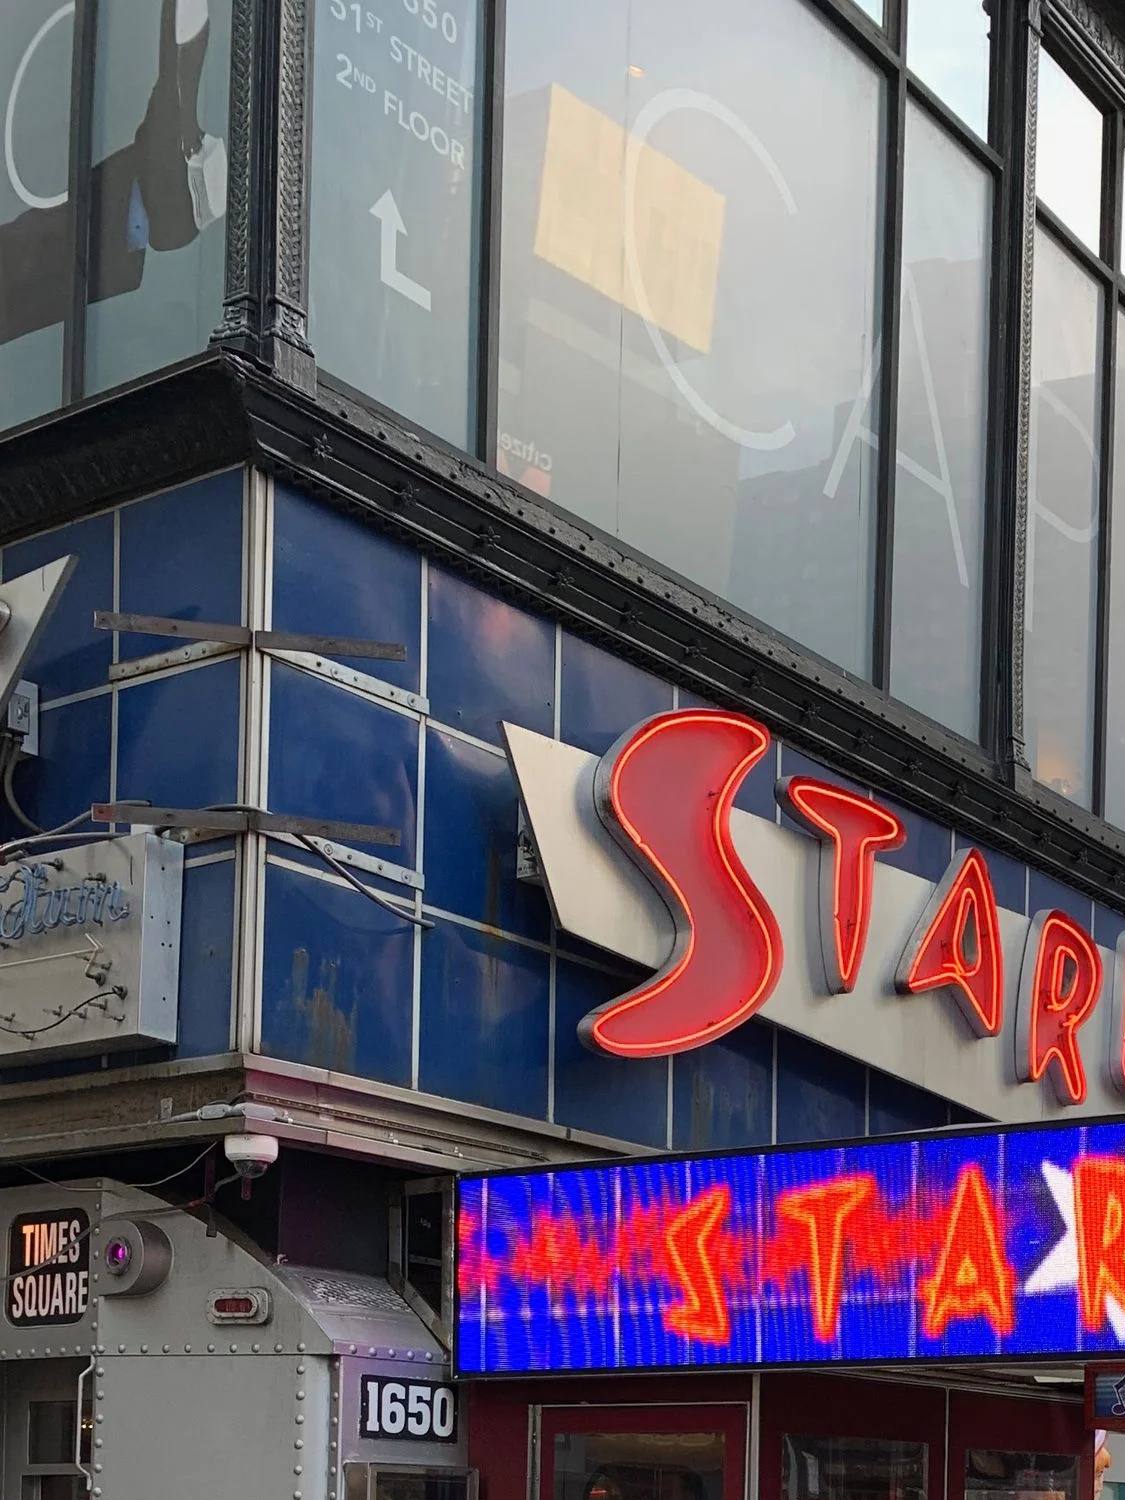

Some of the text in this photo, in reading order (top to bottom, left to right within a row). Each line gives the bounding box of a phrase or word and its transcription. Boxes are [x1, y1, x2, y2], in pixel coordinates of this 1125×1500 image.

[390, 36, 473, 114] STREET
[336, 53, 465, 170] 2ND FLOOR
[21, 1220, 81, 1267] TIMES
[12, 1271, 88, 1318] SQUARE
[365, 1381, 454, 1438] 1650
